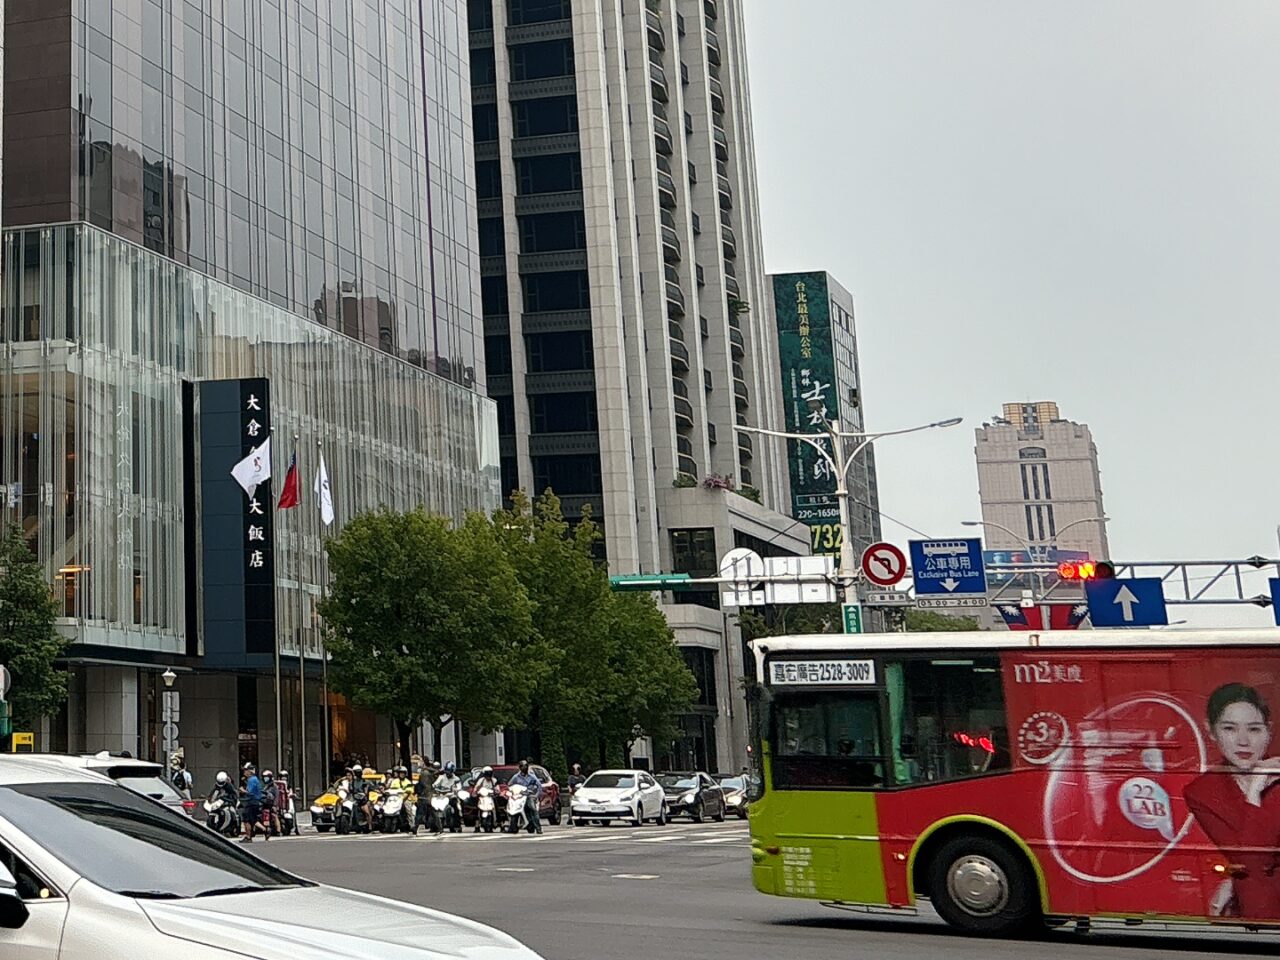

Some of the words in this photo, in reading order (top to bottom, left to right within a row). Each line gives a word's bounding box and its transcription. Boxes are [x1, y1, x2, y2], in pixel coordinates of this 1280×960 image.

[246, 393, 265, 569] 大倉大飯店
[924, 556, 972, 570] 公車專用
[949, 570, 962, 578] Bus
[963, 569, 979, 577] Lane
[1125, 798, 1167, 817] LAB
